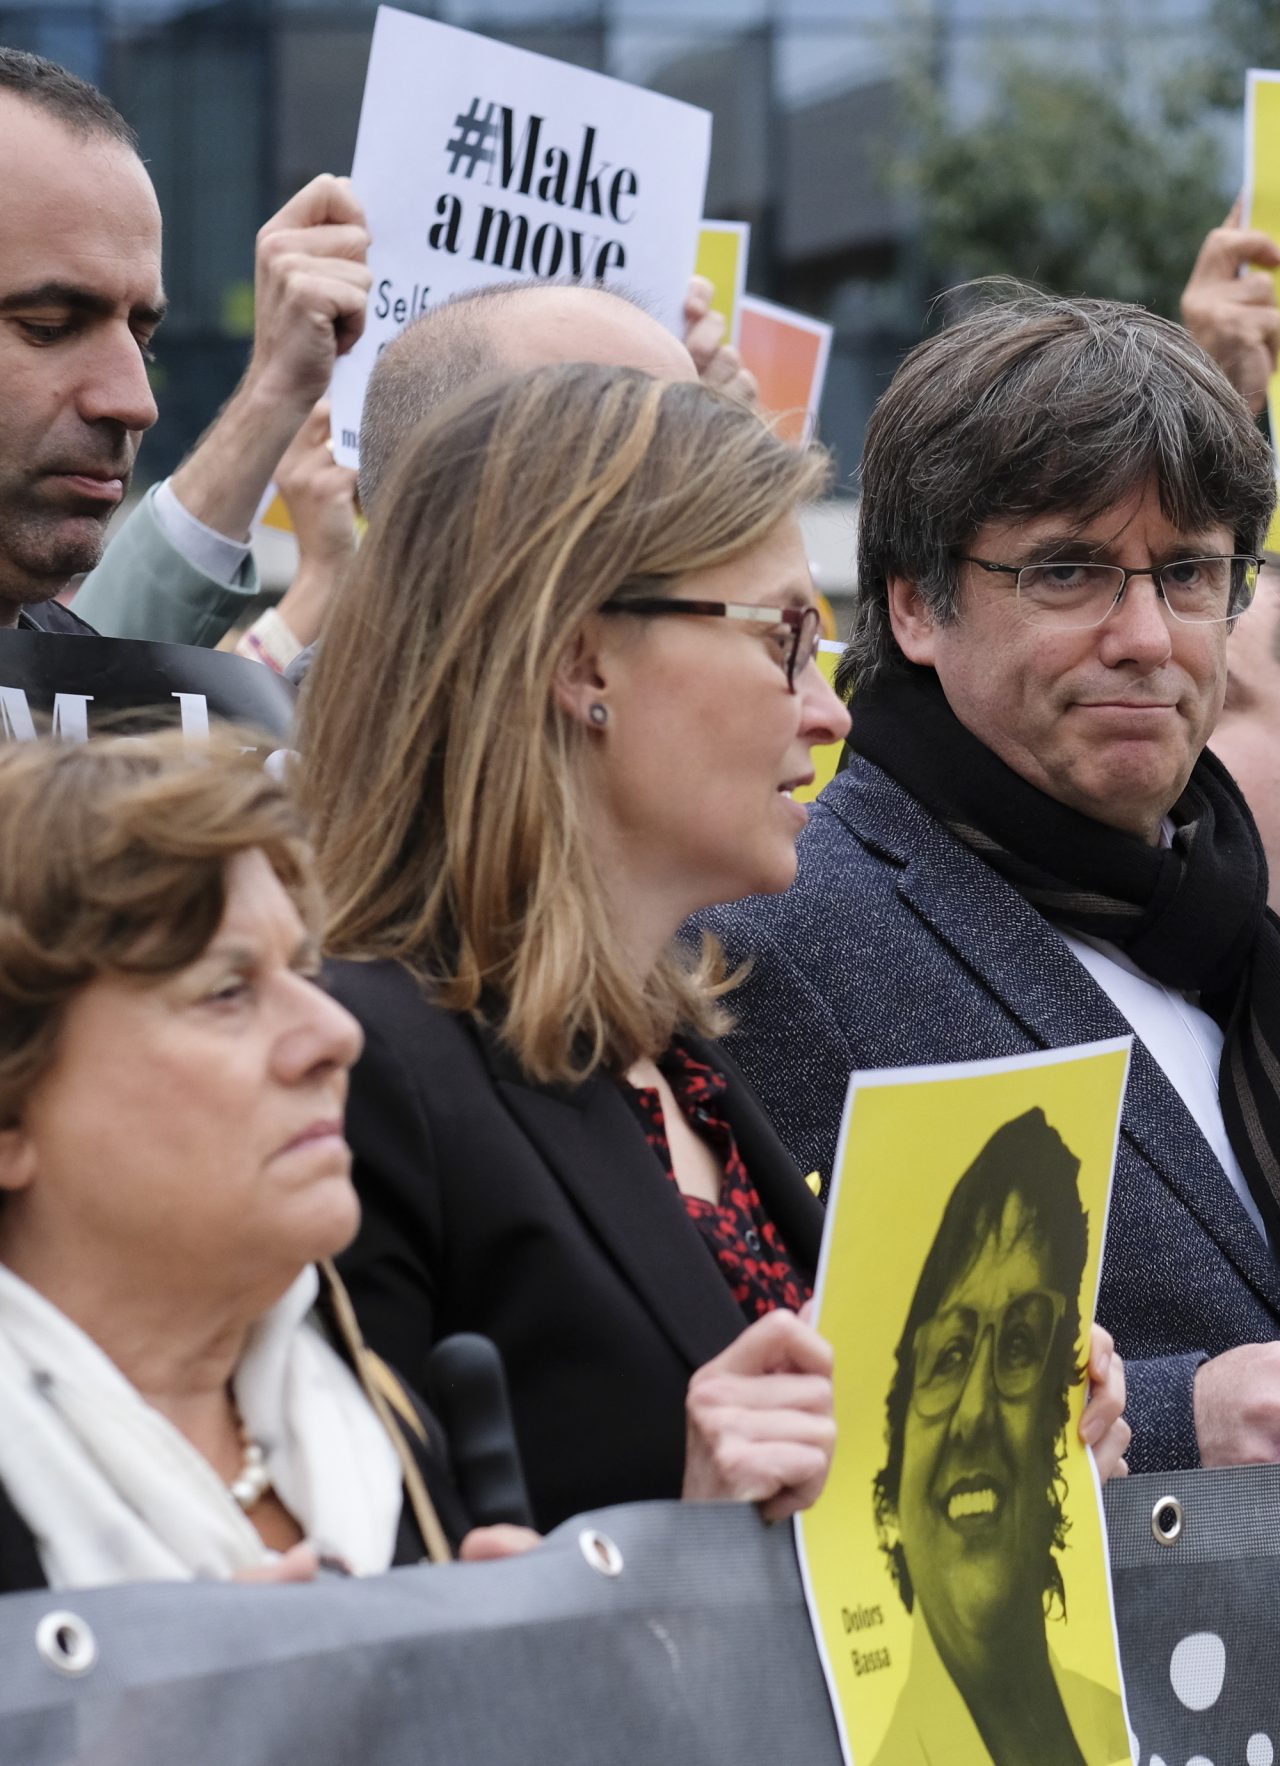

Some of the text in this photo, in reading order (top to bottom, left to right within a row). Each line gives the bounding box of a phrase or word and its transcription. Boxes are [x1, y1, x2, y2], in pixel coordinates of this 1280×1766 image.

[445, 96, 638, 225] #Make
[428, 192, 626, 284] a move
[841, 1603, 884, 1634] Dolors
[851, 1647, 892, 1677] Bassa
